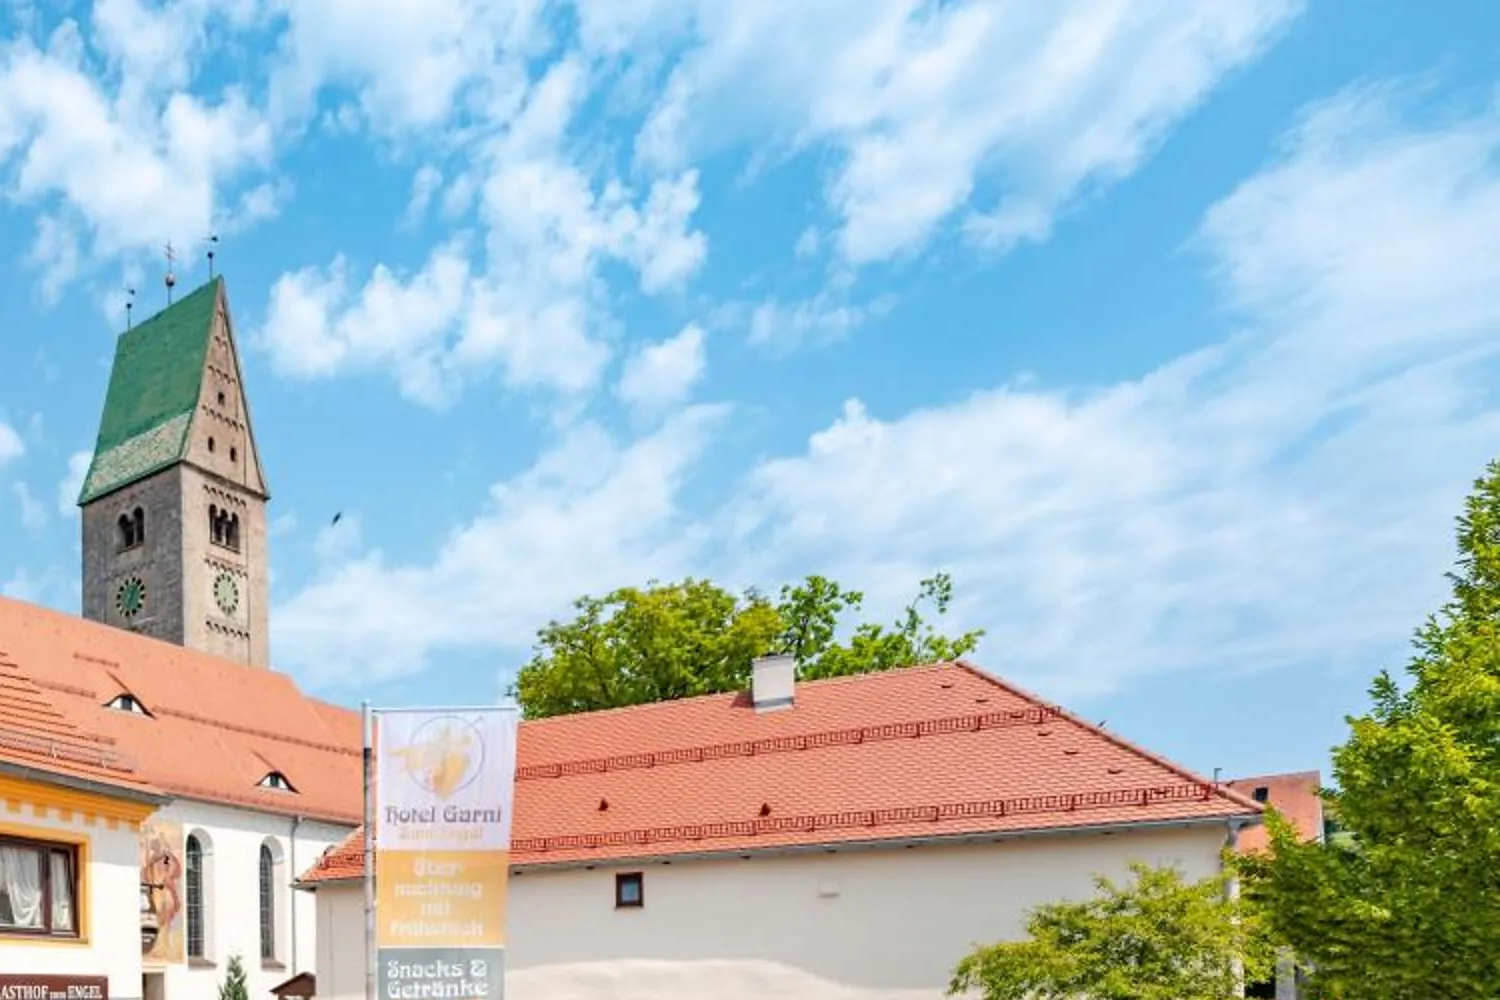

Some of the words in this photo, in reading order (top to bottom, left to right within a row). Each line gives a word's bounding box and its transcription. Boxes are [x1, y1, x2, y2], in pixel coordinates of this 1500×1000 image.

[443, 804, 501, 823] Garni
[387, 959, 463, 979] Snacks
[387, 979, 489, 999] Getränke
